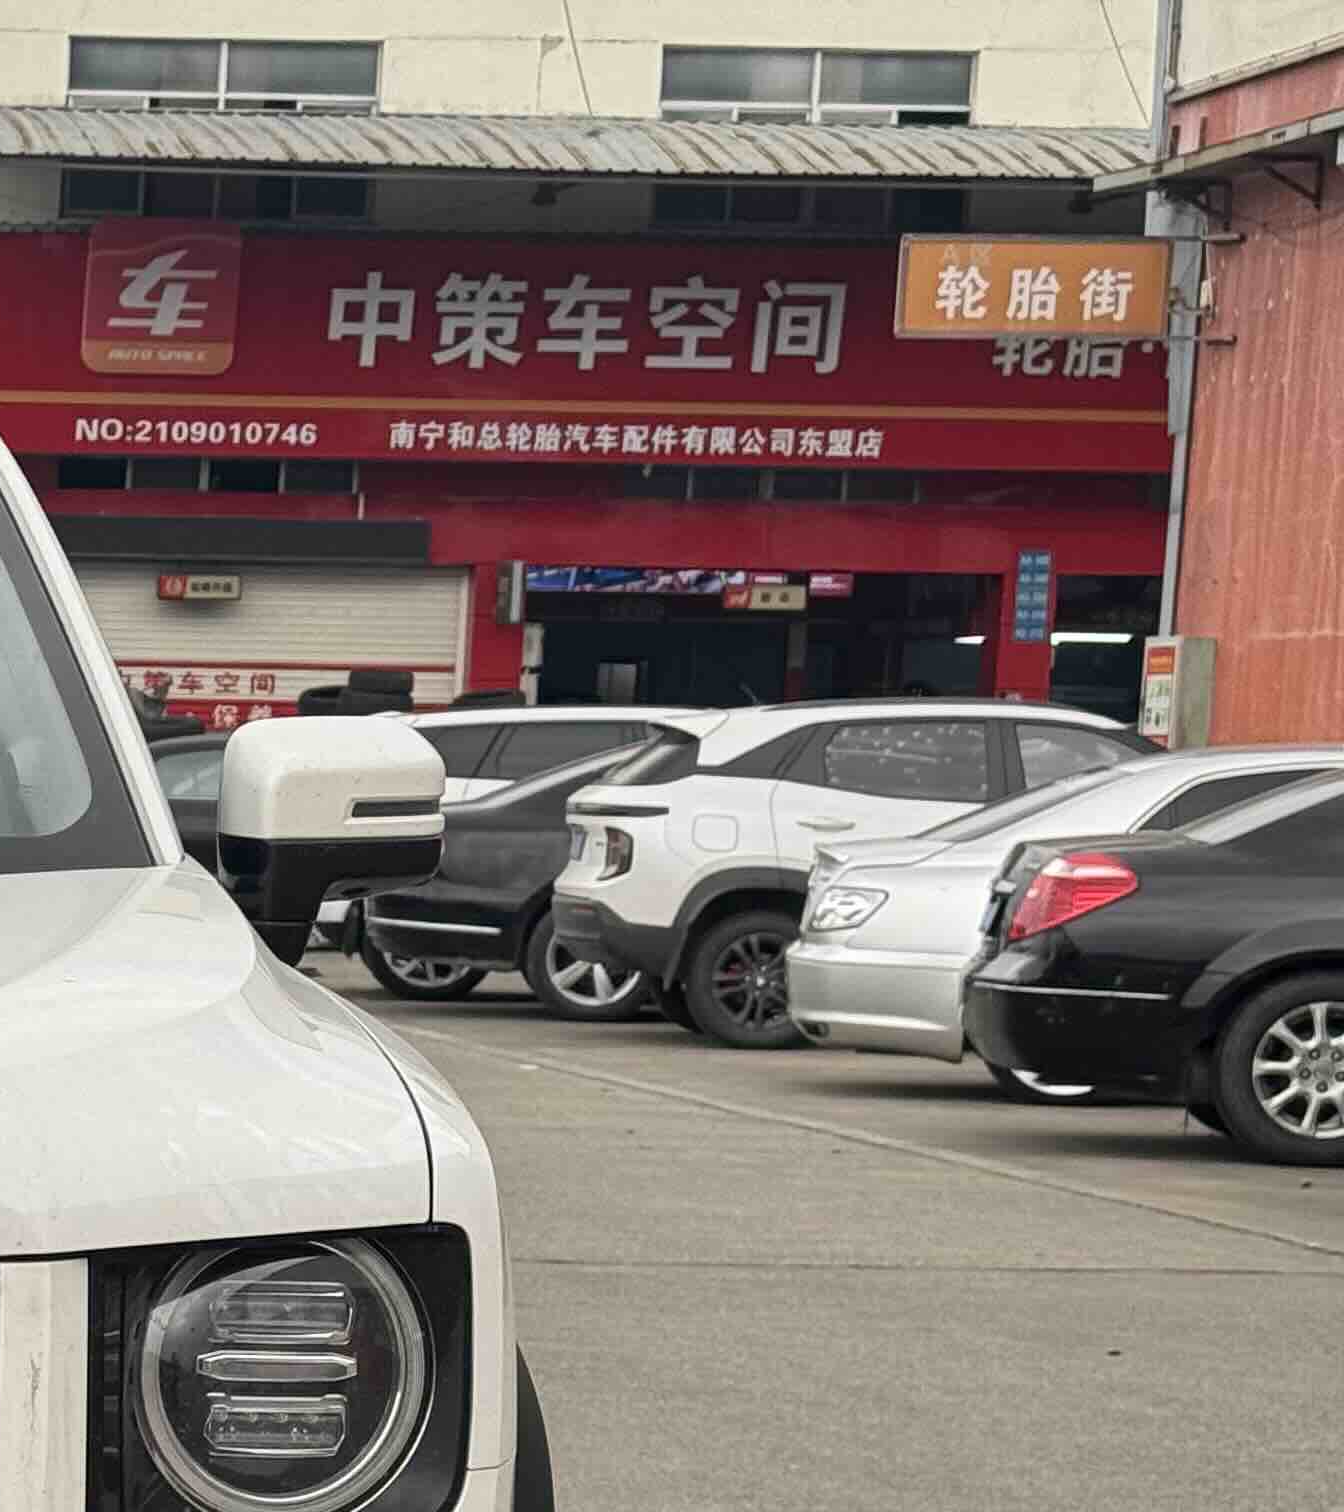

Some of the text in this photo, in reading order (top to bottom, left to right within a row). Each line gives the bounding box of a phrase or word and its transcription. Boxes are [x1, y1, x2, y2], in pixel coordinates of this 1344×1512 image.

[934, 264, 1135, 322] 轮胎街
[326, 270, 849, 374] 中策车空间
[74, 417, 319, 445] NO:2109010746
[389, 419, 884, 458] 南宁和总轮胎汽车配件有限公司东盟店
